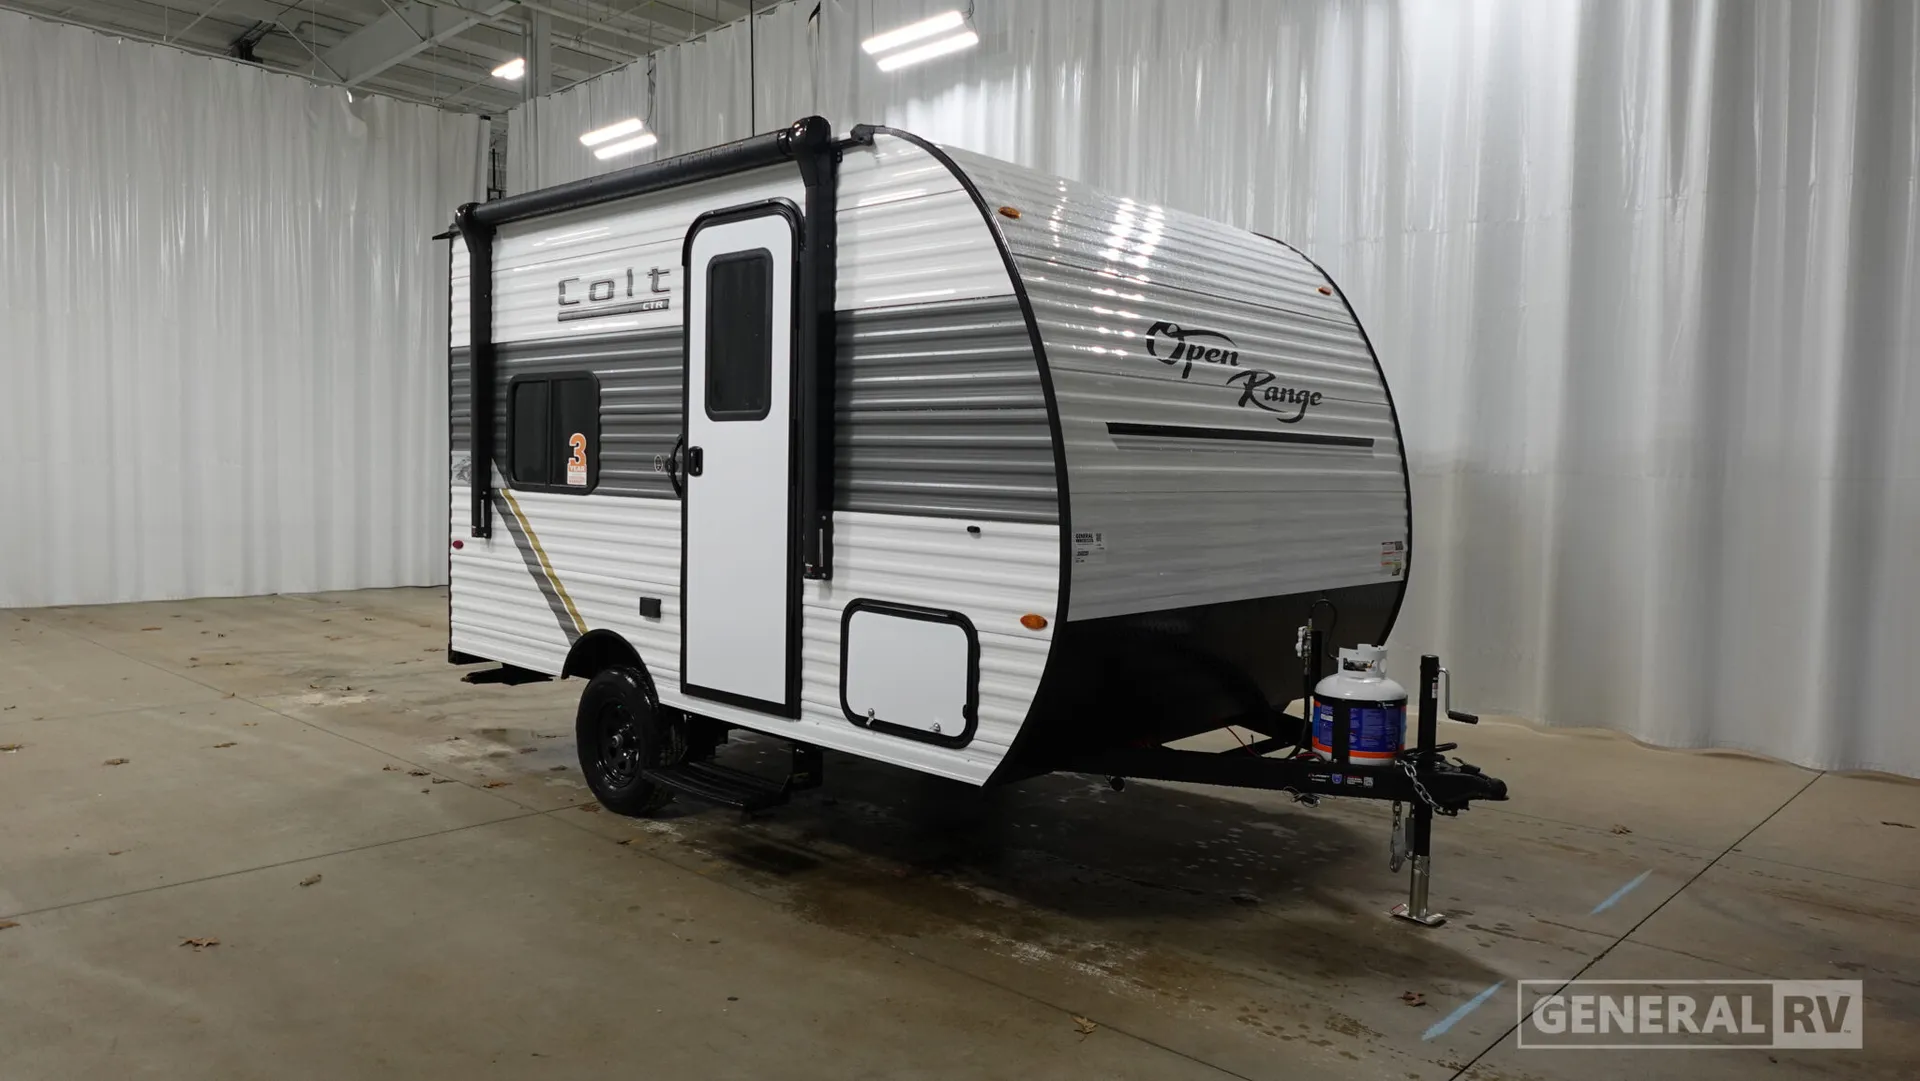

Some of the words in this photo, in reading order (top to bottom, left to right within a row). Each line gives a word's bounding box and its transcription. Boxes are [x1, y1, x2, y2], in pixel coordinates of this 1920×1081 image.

[558, 267, 670, 305] Colt
[642, 301, 664, 310] CTR
[1146, 321, 1240, 379] Open
[1226, 369, 1323, 424] Range
[568, 433, 587, 466] 3
